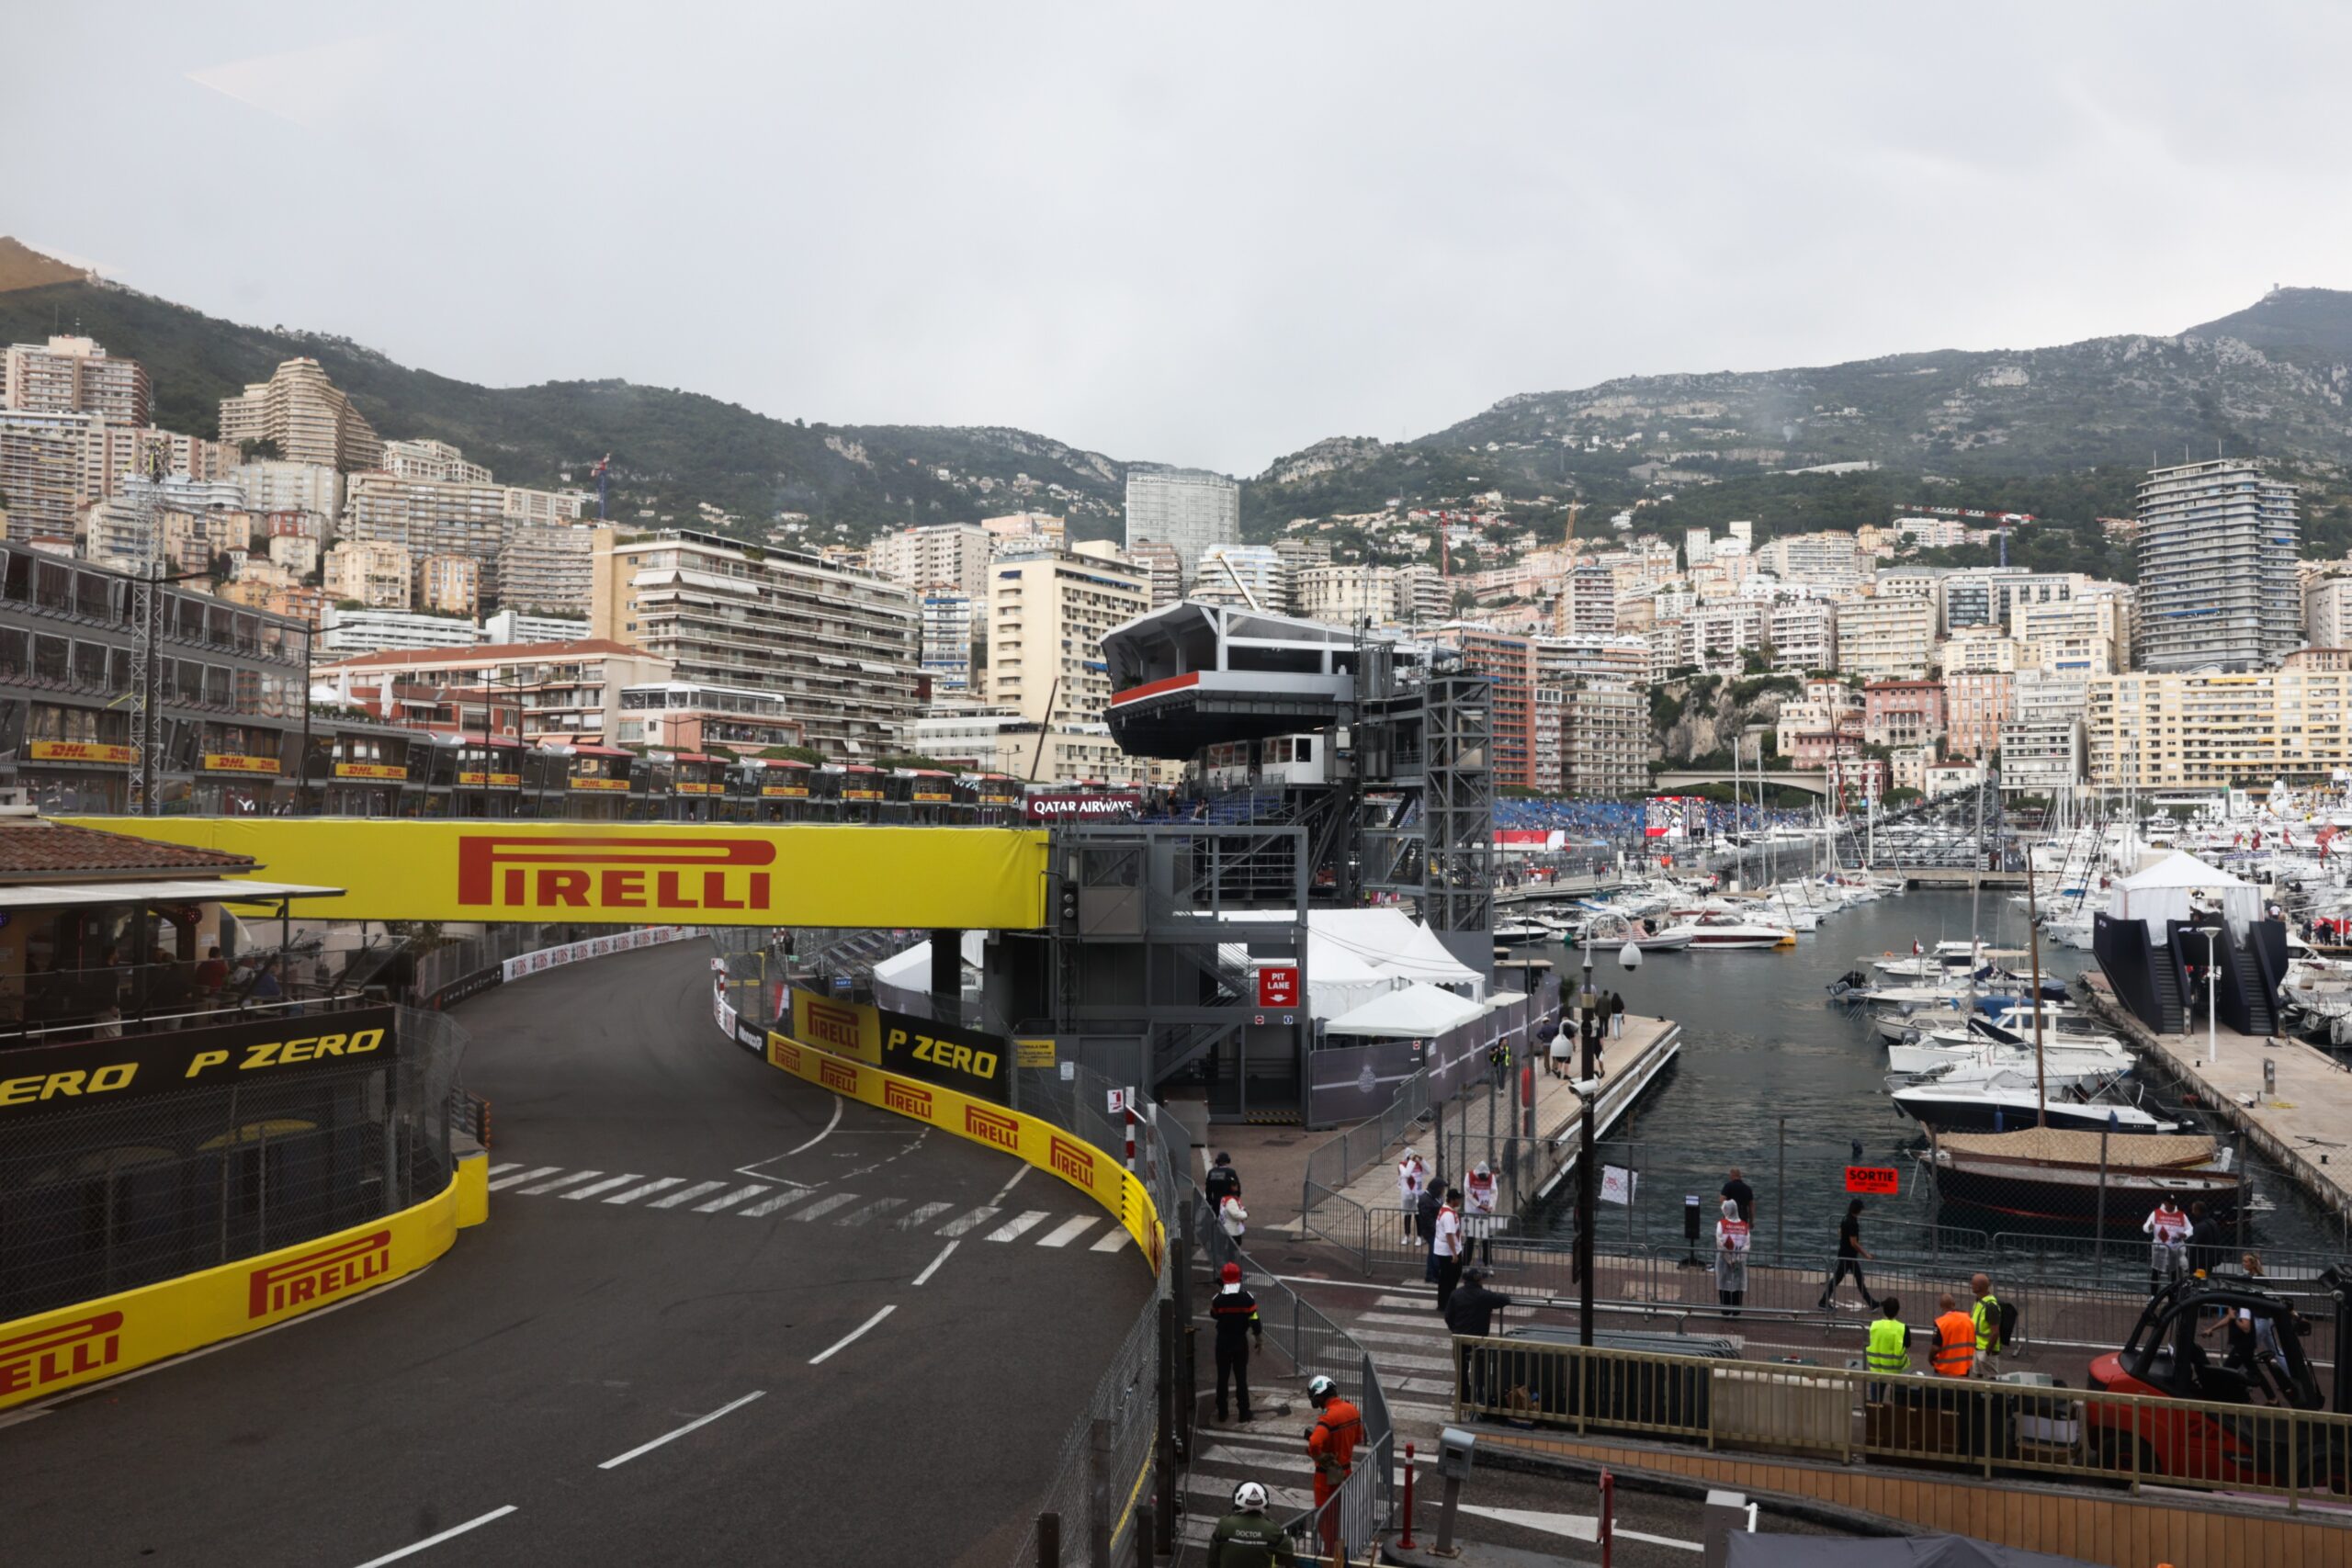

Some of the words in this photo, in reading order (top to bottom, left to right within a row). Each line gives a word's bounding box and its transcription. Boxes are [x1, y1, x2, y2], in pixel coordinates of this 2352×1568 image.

[51, 744, 88, 758] DHL
[219, 757, 244, 768] DHL
[259, 760, 277, 770] DHL
[348, 766, 372, 776] DHL
[387, 768, 402, 777] DHL
[1035, 801, 1076, 815] QATAR
[1079, 801, 1133, 813] AIRWAYS
[458, 836, 776, 909] PIRELLI
[617, 935, 629, 950] UBS
[639, 931, 650, 946] UBS
[658, 929, 670, 942] UBS
[576, 944, 588, 959] UBS
[597, 939, 609, 953] UBS
[537, 953, 548, 968] UBS
[557, 949, 568, 963] UBS
[515, 958, 526, 975] UBS
[808, 1001, 859, 1050] PIRELLI
[187, 1050, 229, 1077] P
[239, 1029, 384, 1069] ZERO
[775, 1041, 800, 1073] PIRELLI
[888, 1029, 907, 1050] P
[912, 1035, 998, 1079] ZERO
[820, 1059, 857, 1094] PIRELLI
[885, 1079, 933, 1119] PIRELLI
[966, 1104, 1019, 1150] PIRELLI
[1050, 1135, 1093, 1190] PIRELLI
[1849, 1169, 1894, 1181] SORTIE
[248, 1230, 391, 1319] PIRELLI
[1236, 1529, 1261, 1538] DOCTOR
